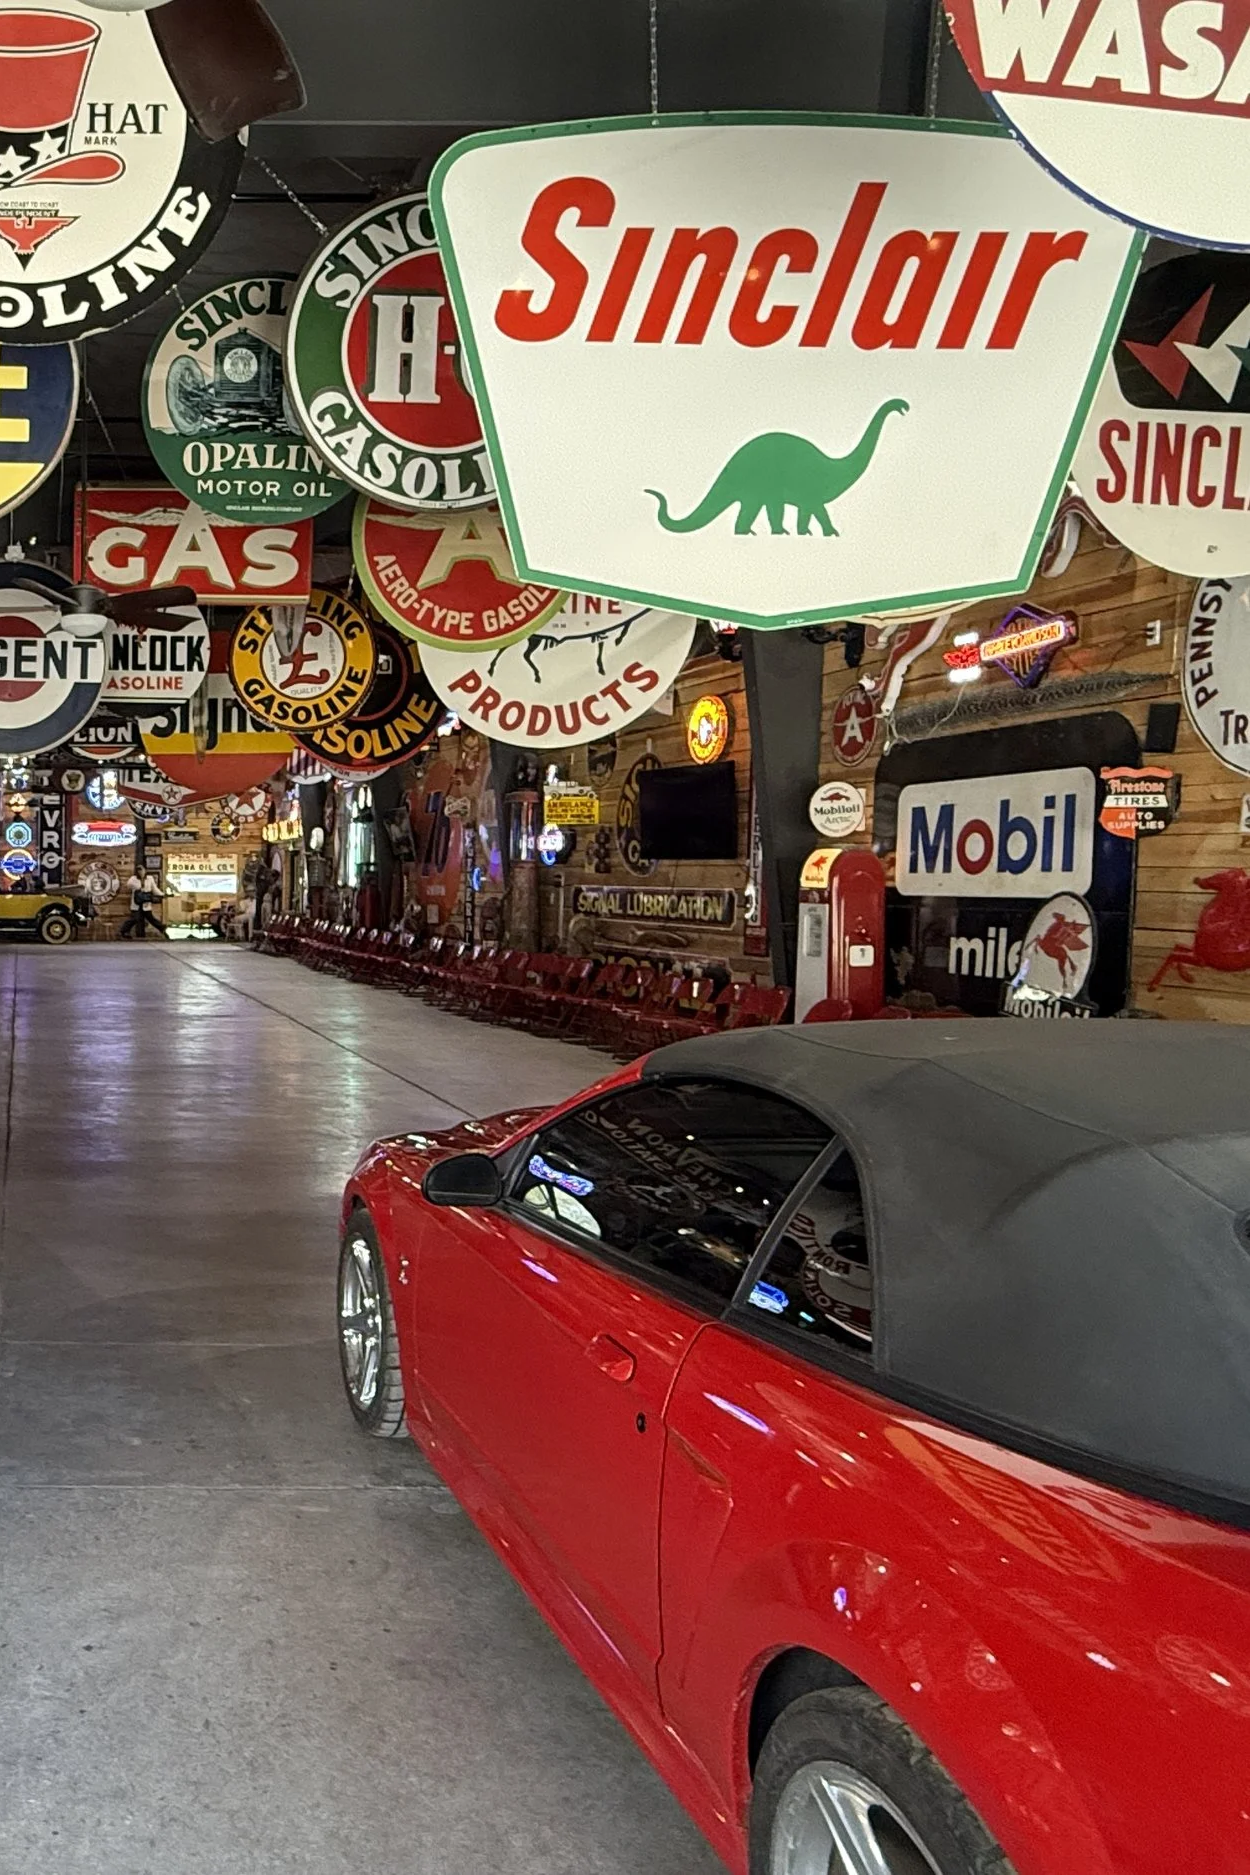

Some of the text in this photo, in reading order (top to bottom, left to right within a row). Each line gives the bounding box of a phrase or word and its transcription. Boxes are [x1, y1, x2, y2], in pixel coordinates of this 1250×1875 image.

[86, 102, 169, 135] HAT
[83, 135, 118, 146] MARK
[494, 175, 1090, 352] Sinclair
[182, 441, 342, 480] OPALIN
[1096, 418, 1250, 512] SINCL
[196, 478, 333, 498] MOTOR OIL
[87, 501, 300, 591] GAS
[373, 554, 475, 635] AERO-TYPE
[109, 633, 207, 673] NCOCK
[242, 664, 370, 725] GASOLINE
[447, 660, 661, 738] PRODUCTS
[1109, 779, 1165, 794] Firestone
[1112, 796, 1160, 806] TIRES
[813, 804, 861, 816] Mobiloil
[1106, 820, 1166, 831] SUPPLIES
[1117, 811, 1154, 820] AUTO
[908, 793, 1077, 875] Mobil
[577, 892, 725, 922] SIGNAL LUBRICATION
